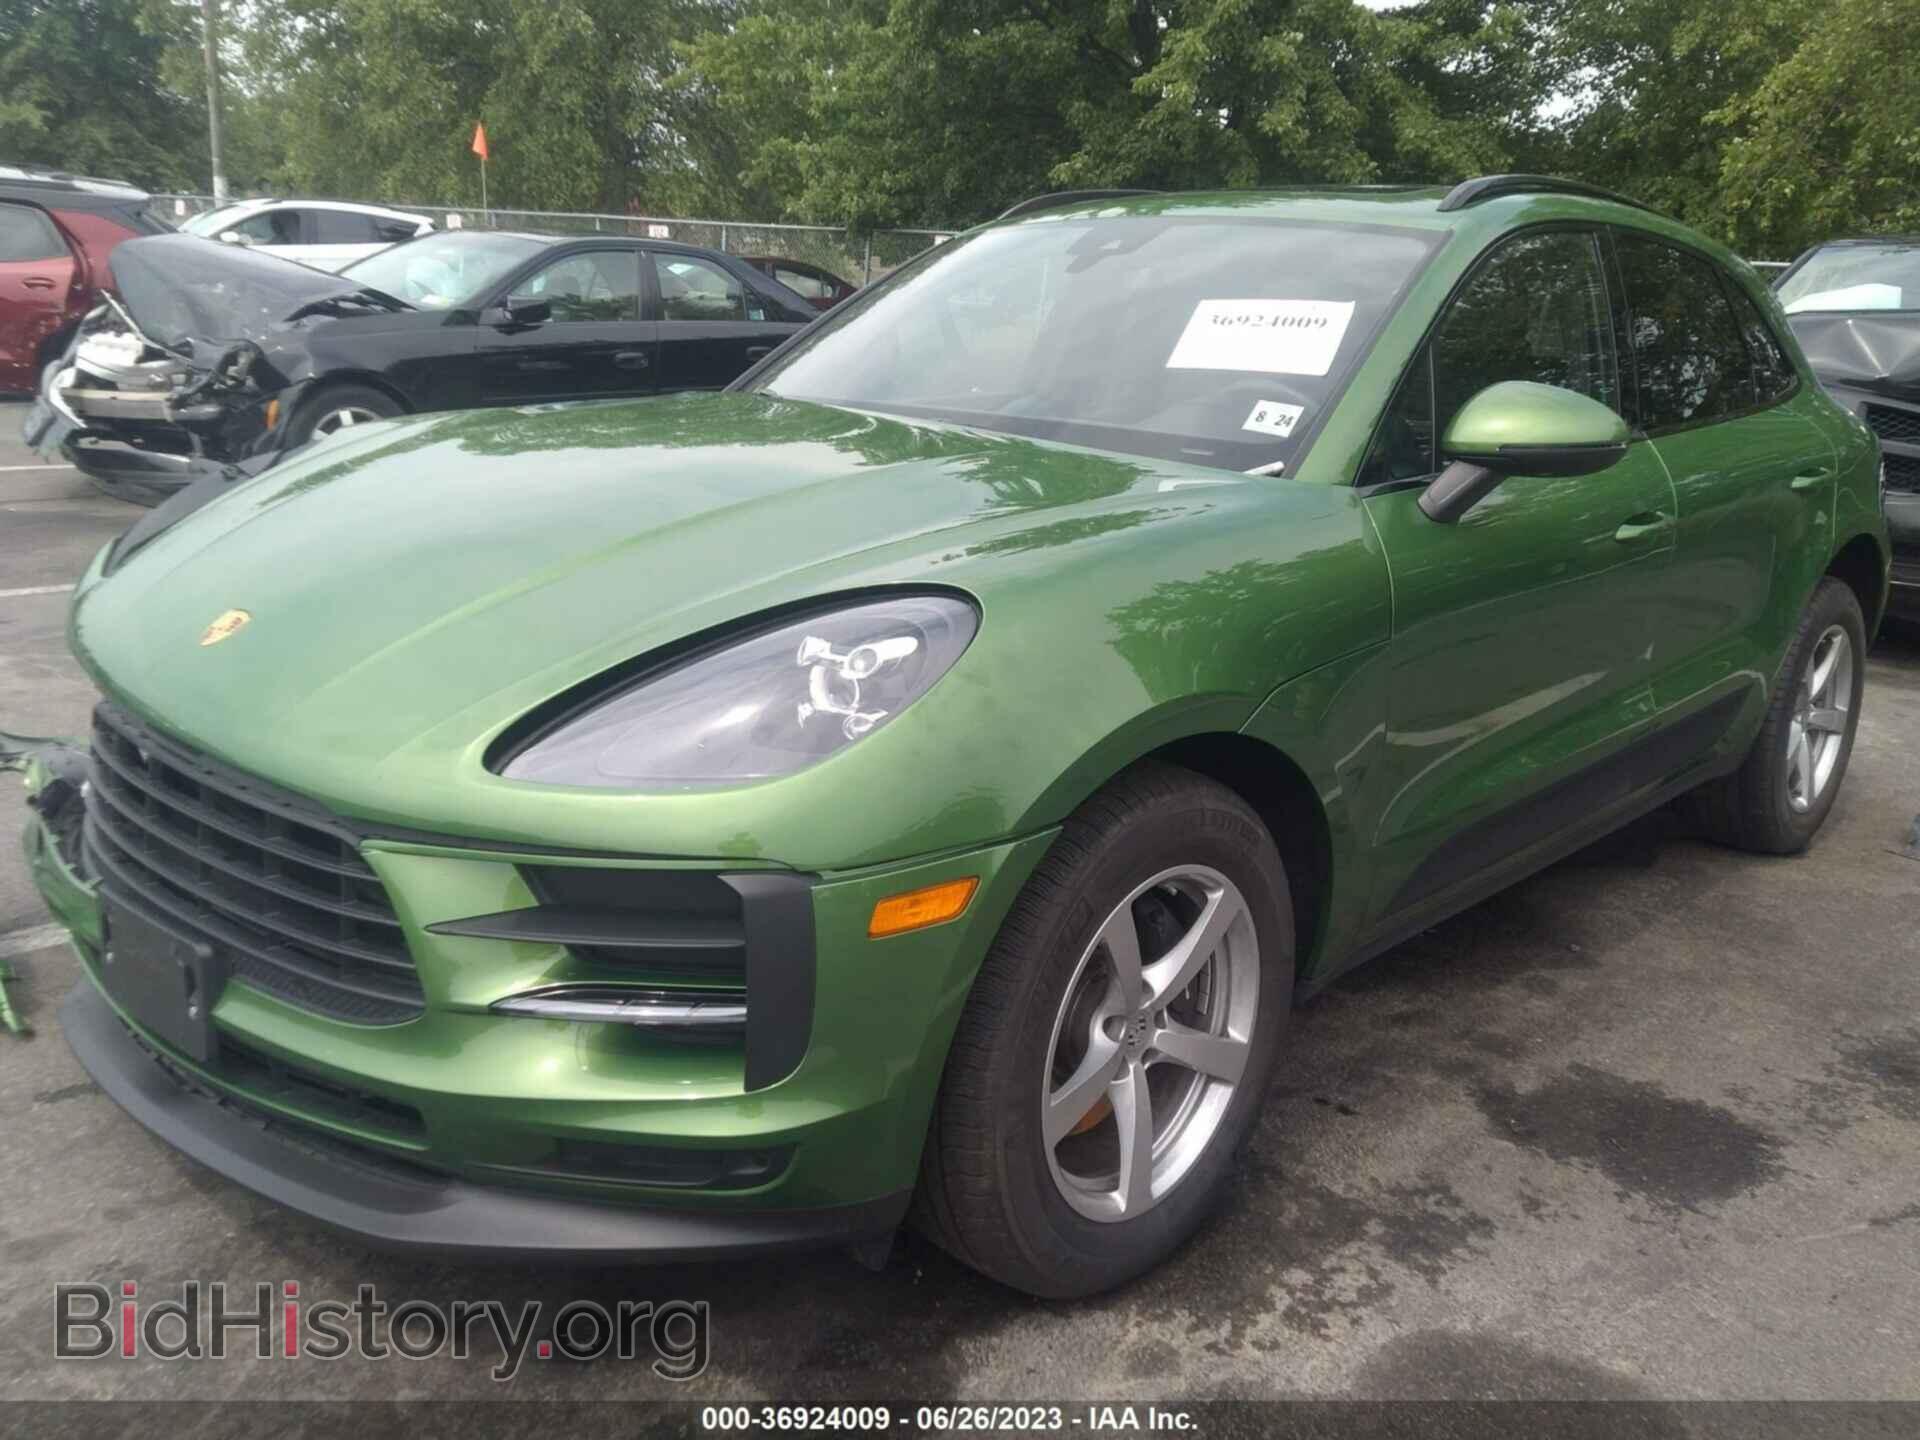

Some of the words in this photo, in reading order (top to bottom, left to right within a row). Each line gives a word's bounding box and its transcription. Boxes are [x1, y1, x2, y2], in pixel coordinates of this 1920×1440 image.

[1210, 313, 1329, 329] 36924009
[1255, 410, 1267, 423] 8
[1274, 414, 1295, 428] 24
